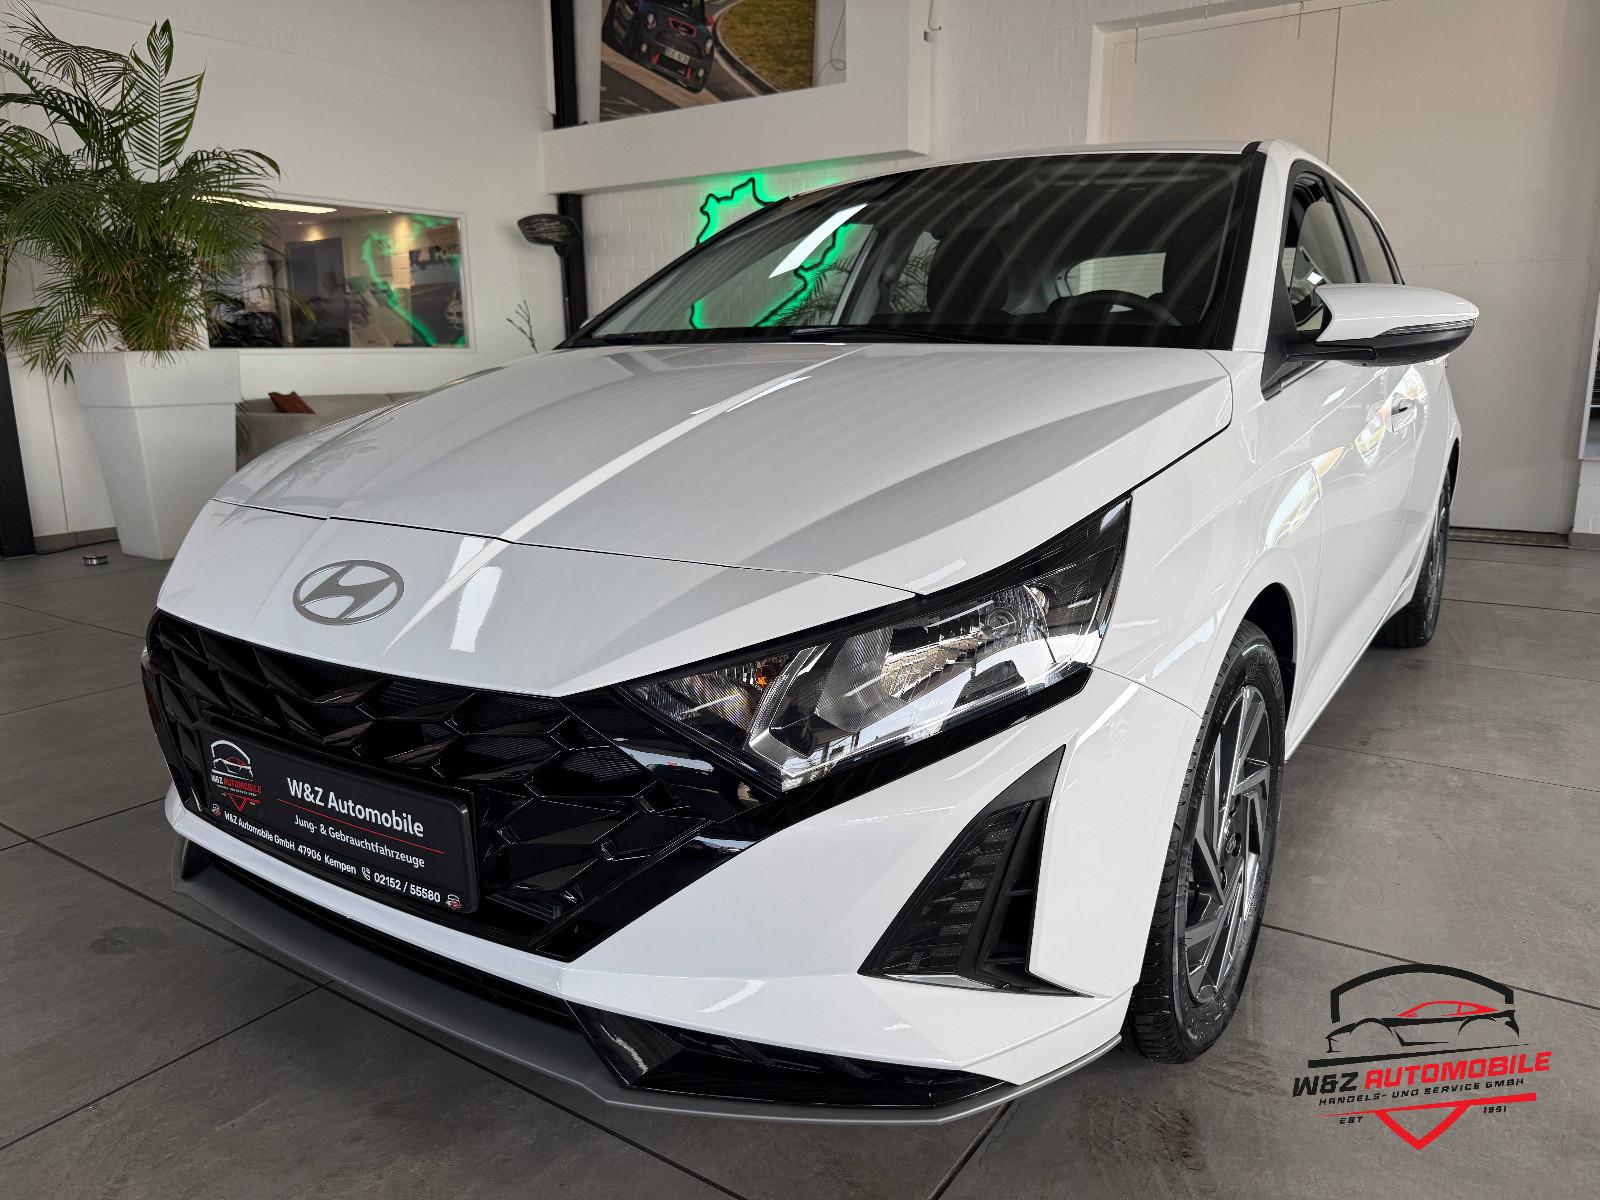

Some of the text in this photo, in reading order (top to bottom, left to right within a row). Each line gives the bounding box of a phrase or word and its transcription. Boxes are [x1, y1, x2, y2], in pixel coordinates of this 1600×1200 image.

[287, 777, 424, 838] W&Z Automobile
[224, 806, 238, 825] W&Z
[238, 818, 273, 842] Automobile
[274, 834, 295, 851] GmbH
[298, 844, 322, 861] 47906
[324, 853, 357, 875] Kempen
[374, 872, 402, 891] 02152
[409, 884, 441, 903] 55580
[294, 814, 425, 868] Jung- & Gebrauchtfahrzeuge
